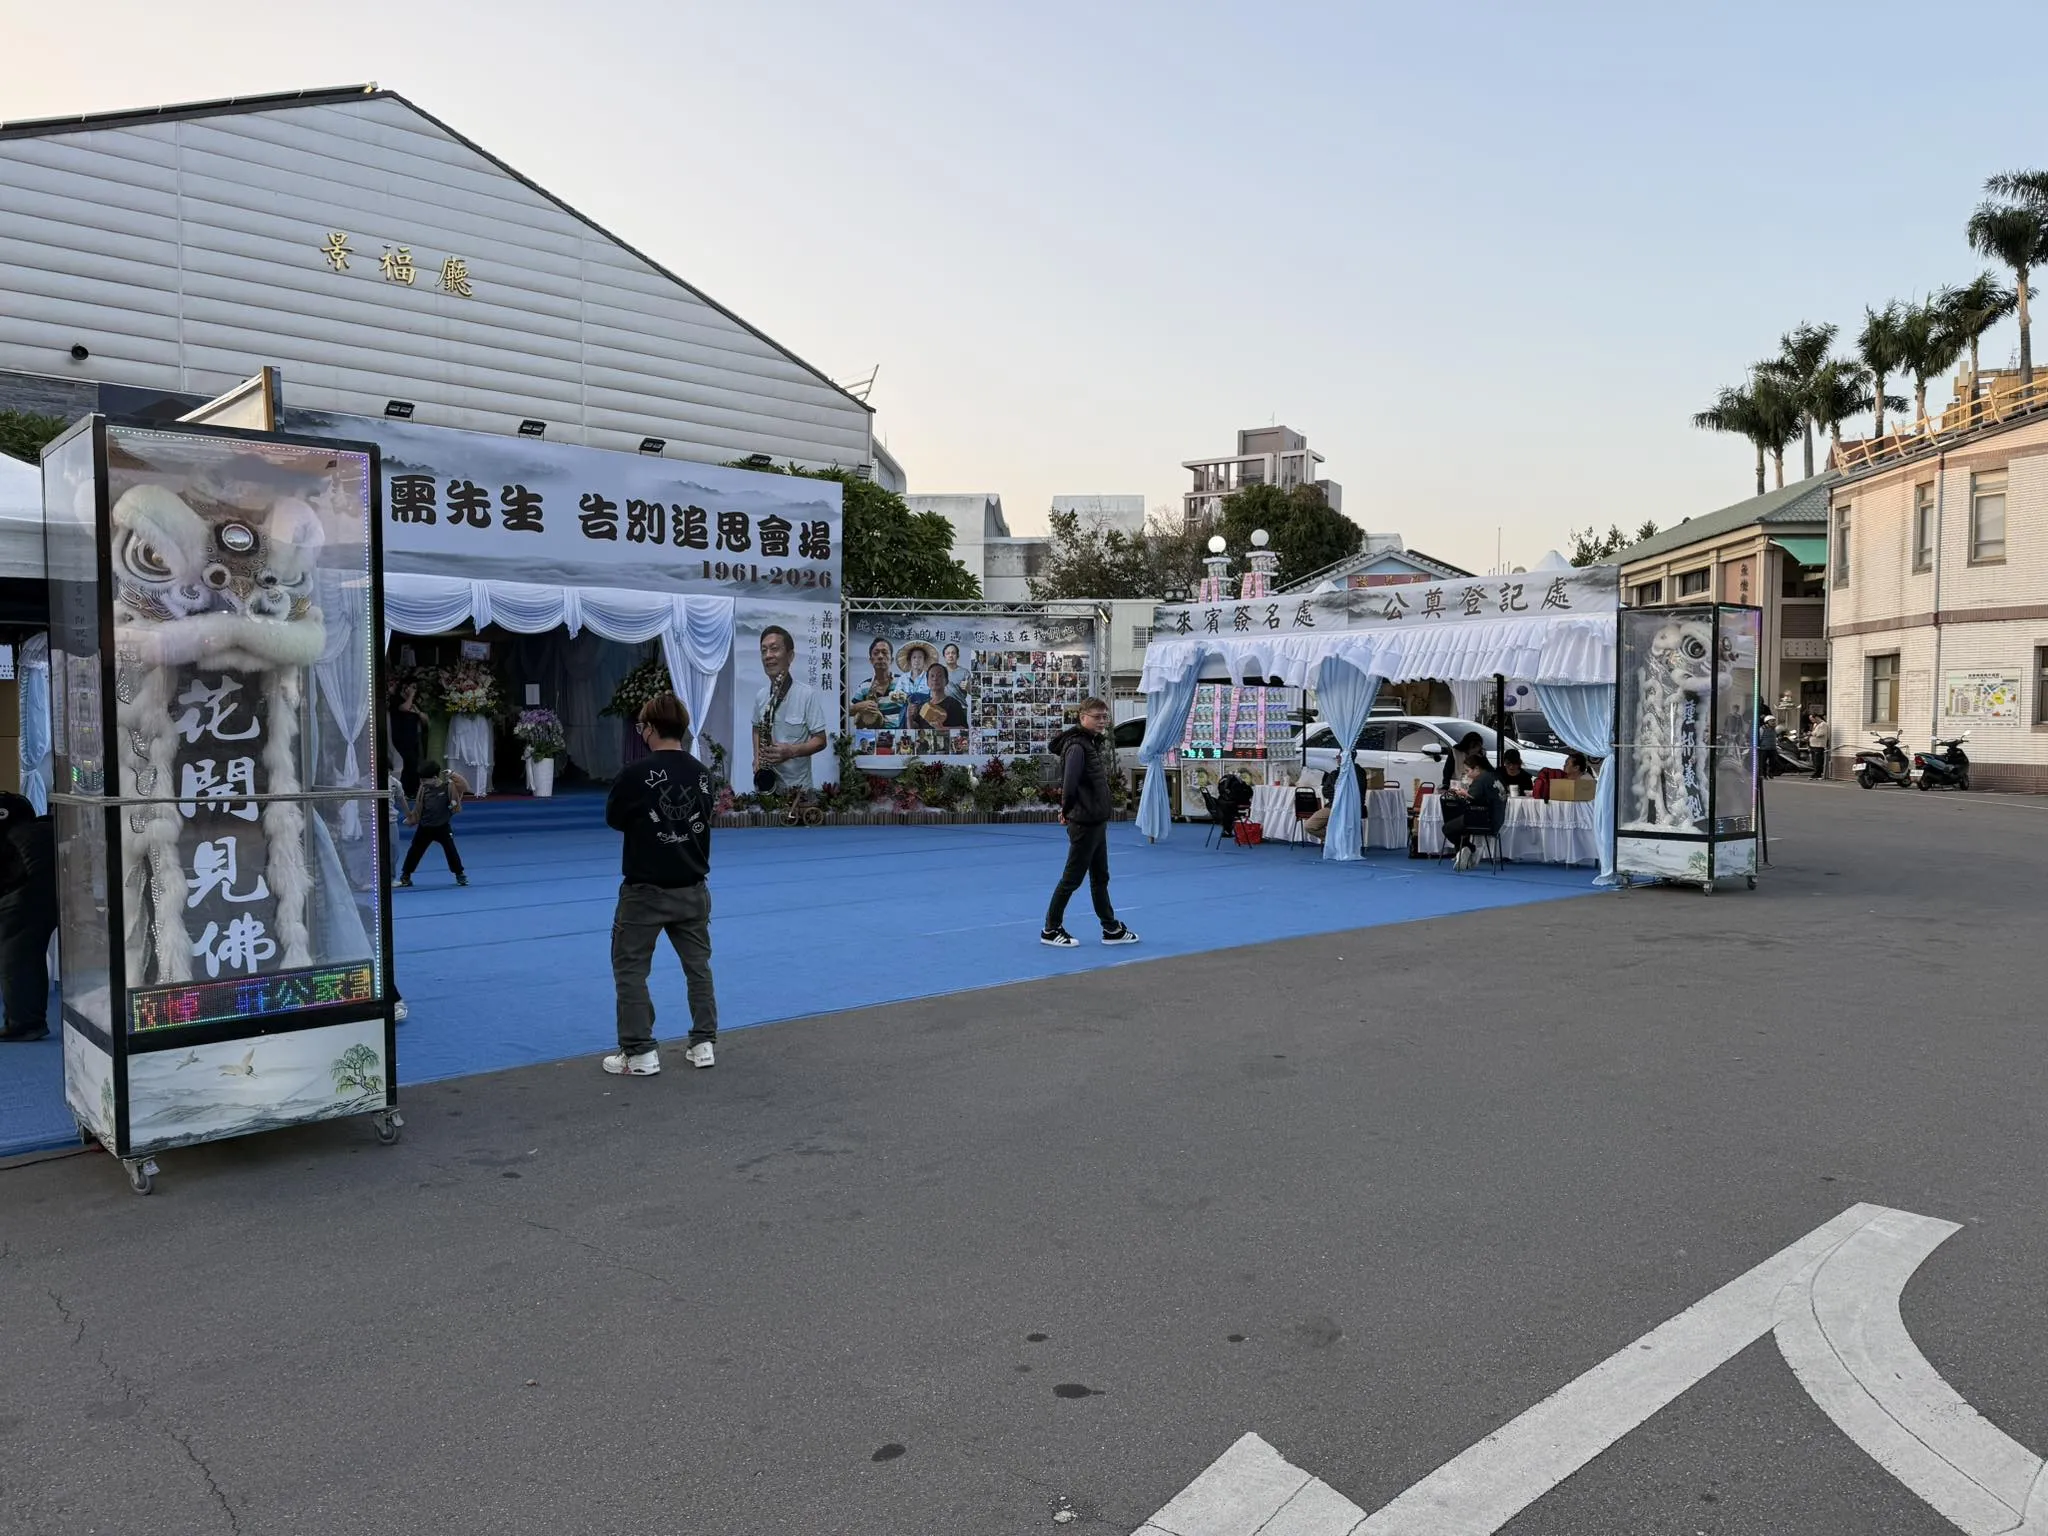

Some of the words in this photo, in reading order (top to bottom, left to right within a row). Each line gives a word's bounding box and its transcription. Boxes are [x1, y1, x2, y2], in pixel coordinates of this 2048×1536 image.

[320, 232, 473, 297] 景福廳
[390, 474, 545, 533] 需先生
[578, 493, 831, 560] 告別追思會場
[702, 559, 832, 589] 1961-2026
[1384, 576, 1573, 621] 公奠登記處
[820, 610, 833, 691] 善的累積
[1176, 600, 1316, 636] 來賓簽名處
[174, 675, 277, 977] 花開見佛
